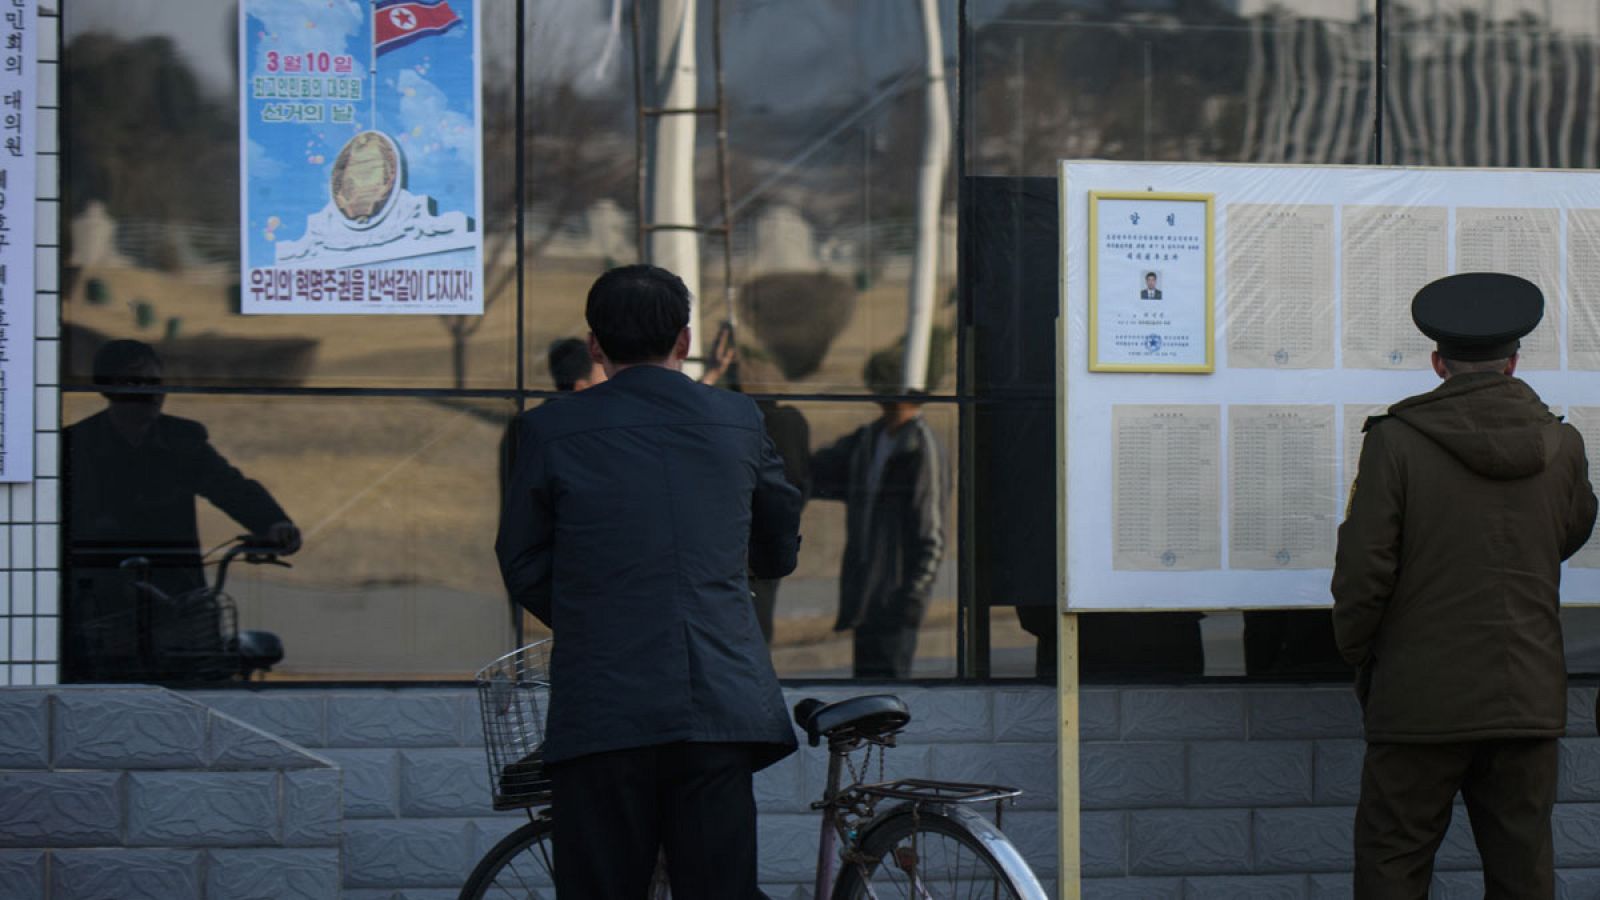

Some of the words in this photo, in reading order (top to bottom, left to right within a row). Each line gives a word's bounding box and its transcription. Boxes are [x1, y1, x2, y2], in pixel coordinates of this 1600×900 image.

[267, 51, 302, 73] 3월
[306, 52, 353, 73] 10일
[4, 90, 23, 157] 대의원
[263, 104, 323, 121] 선거의
[249, 269, 293, 301] 우리의
[296, 269, 364, 301] 혁명주권을
[368, 269, 423, 301] 반석같이
[427, 269, 472, 301] 다지자!
